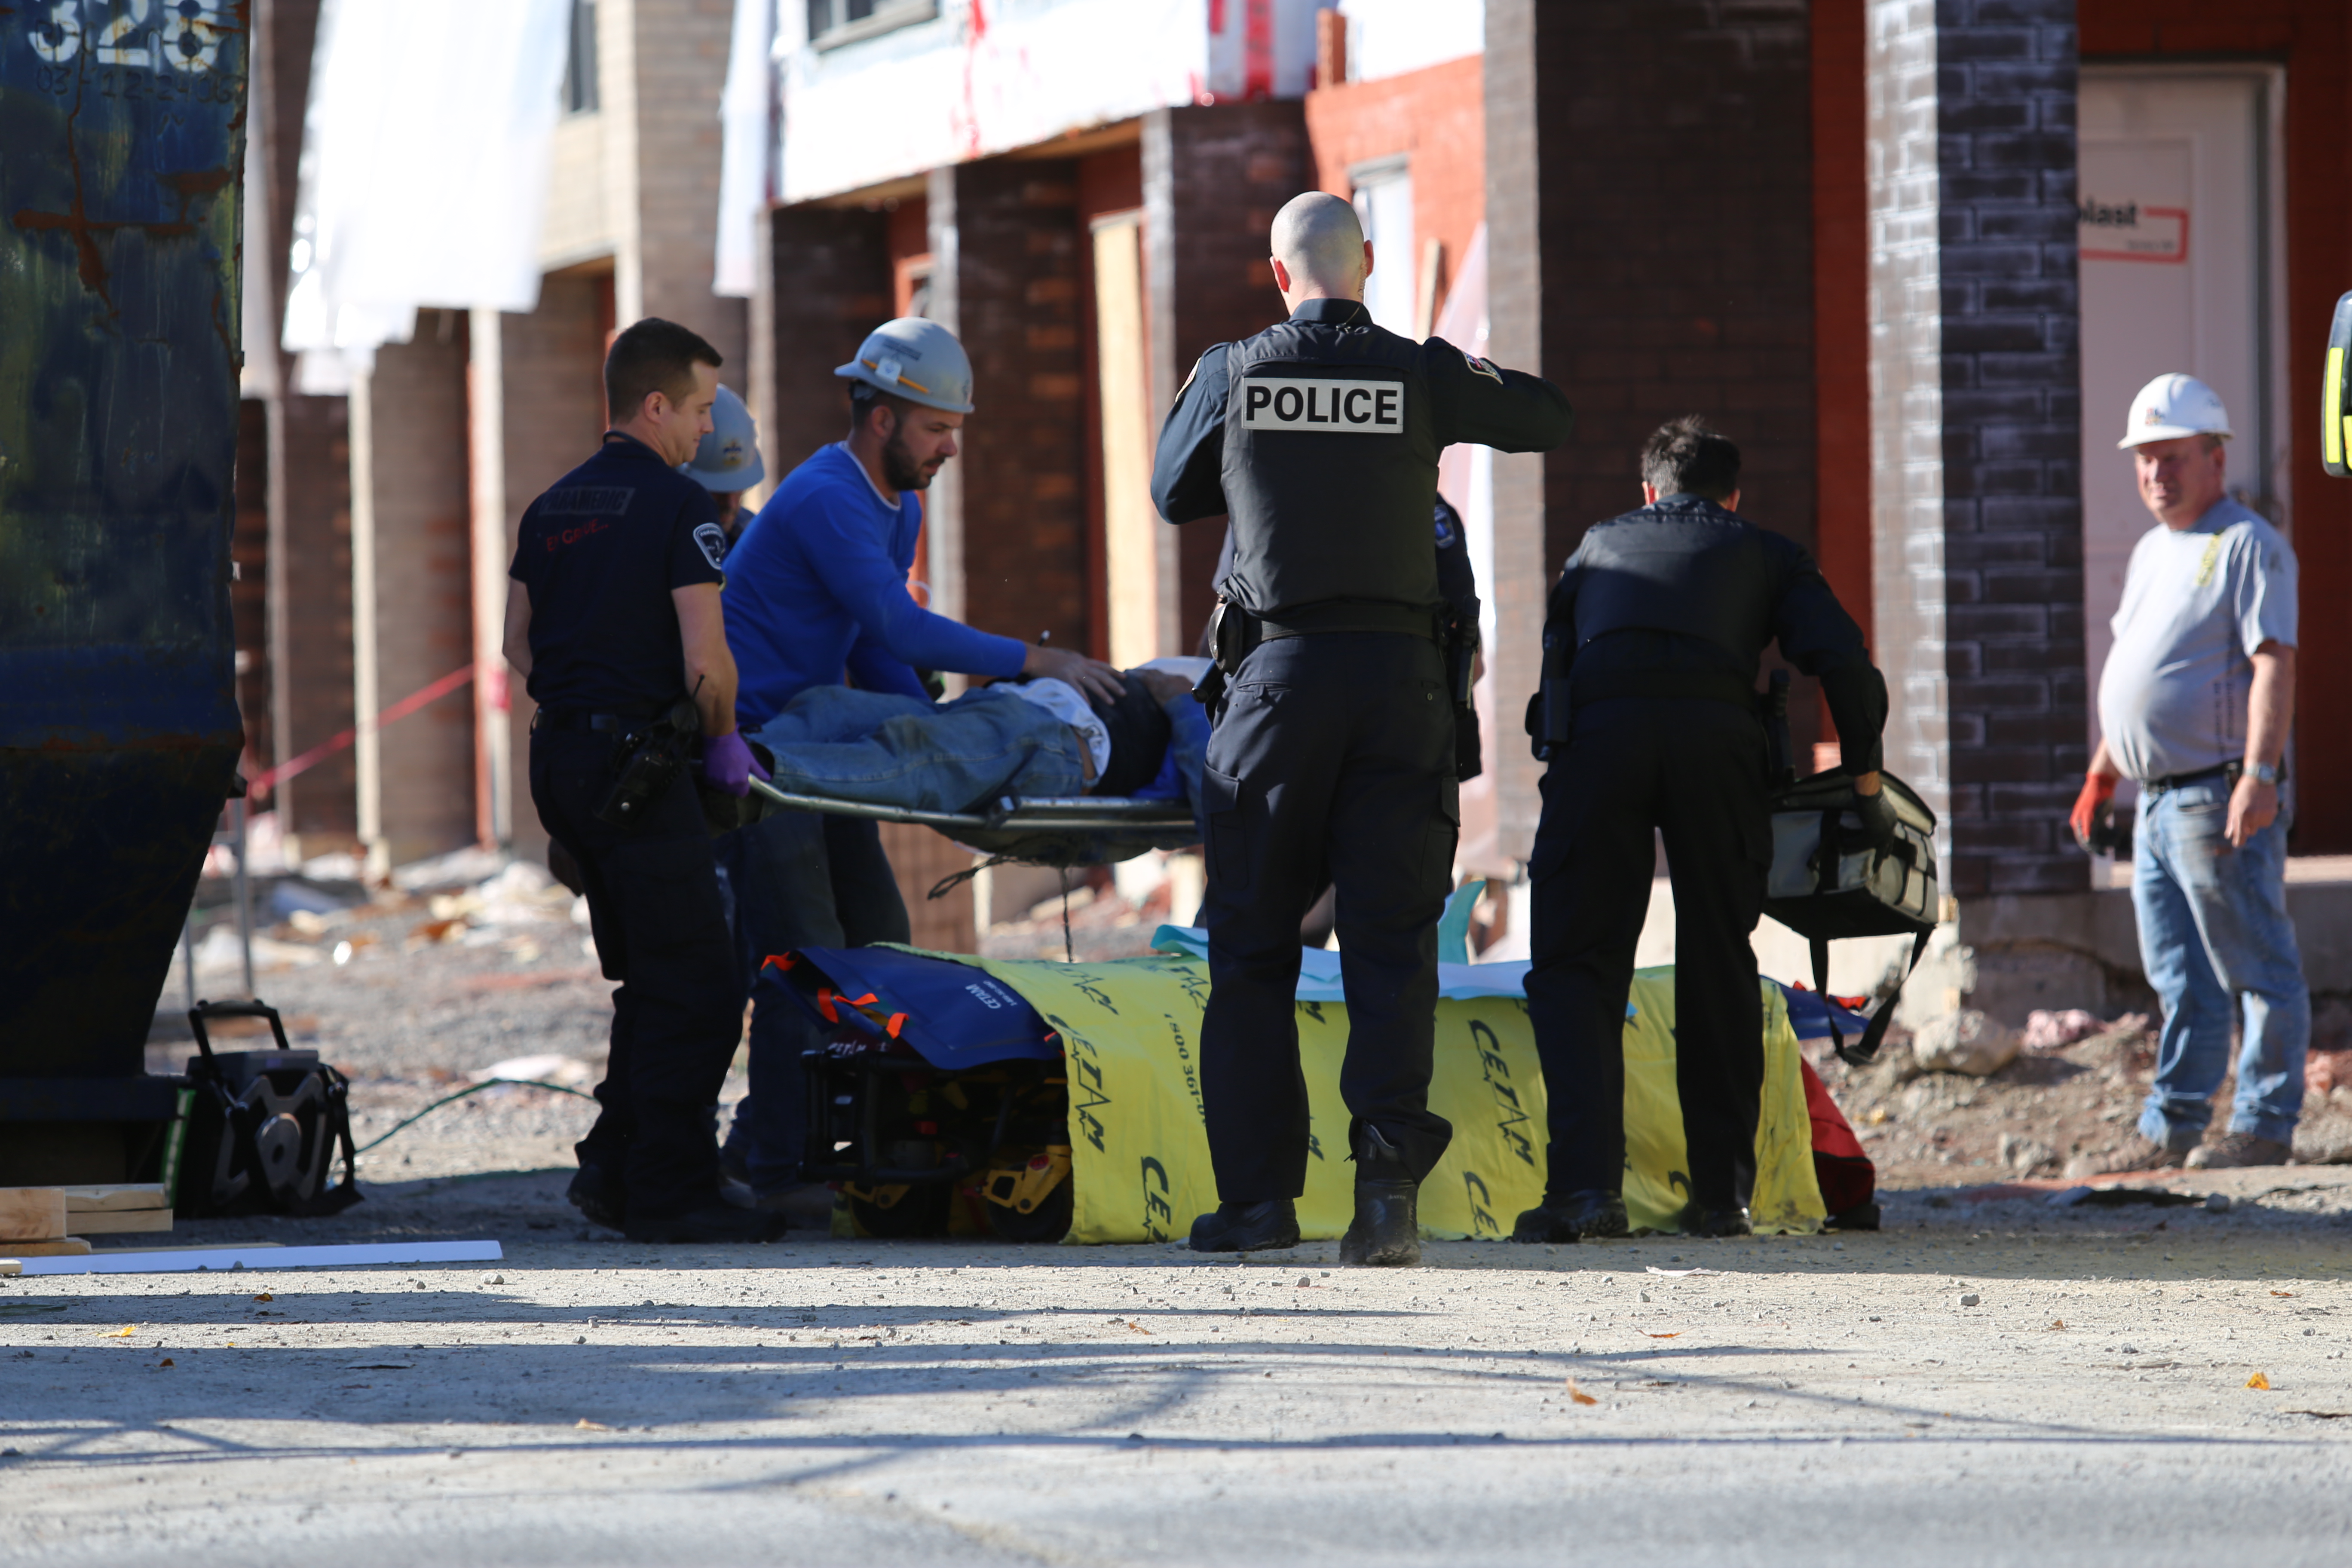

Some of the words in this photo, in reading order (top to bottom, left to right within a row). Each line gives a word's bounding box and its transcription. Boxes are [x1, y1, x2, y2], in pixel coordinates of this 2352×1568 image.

[1246, 386, 1398, 425] POLICE
[965, 983, 1002, 1009] CETAM
[1169, 1022, 1190, 1060] 800
[1182, 1064, 1206, 1126] 361-0
[1467, 1019, 1534, 1167] CETAM
